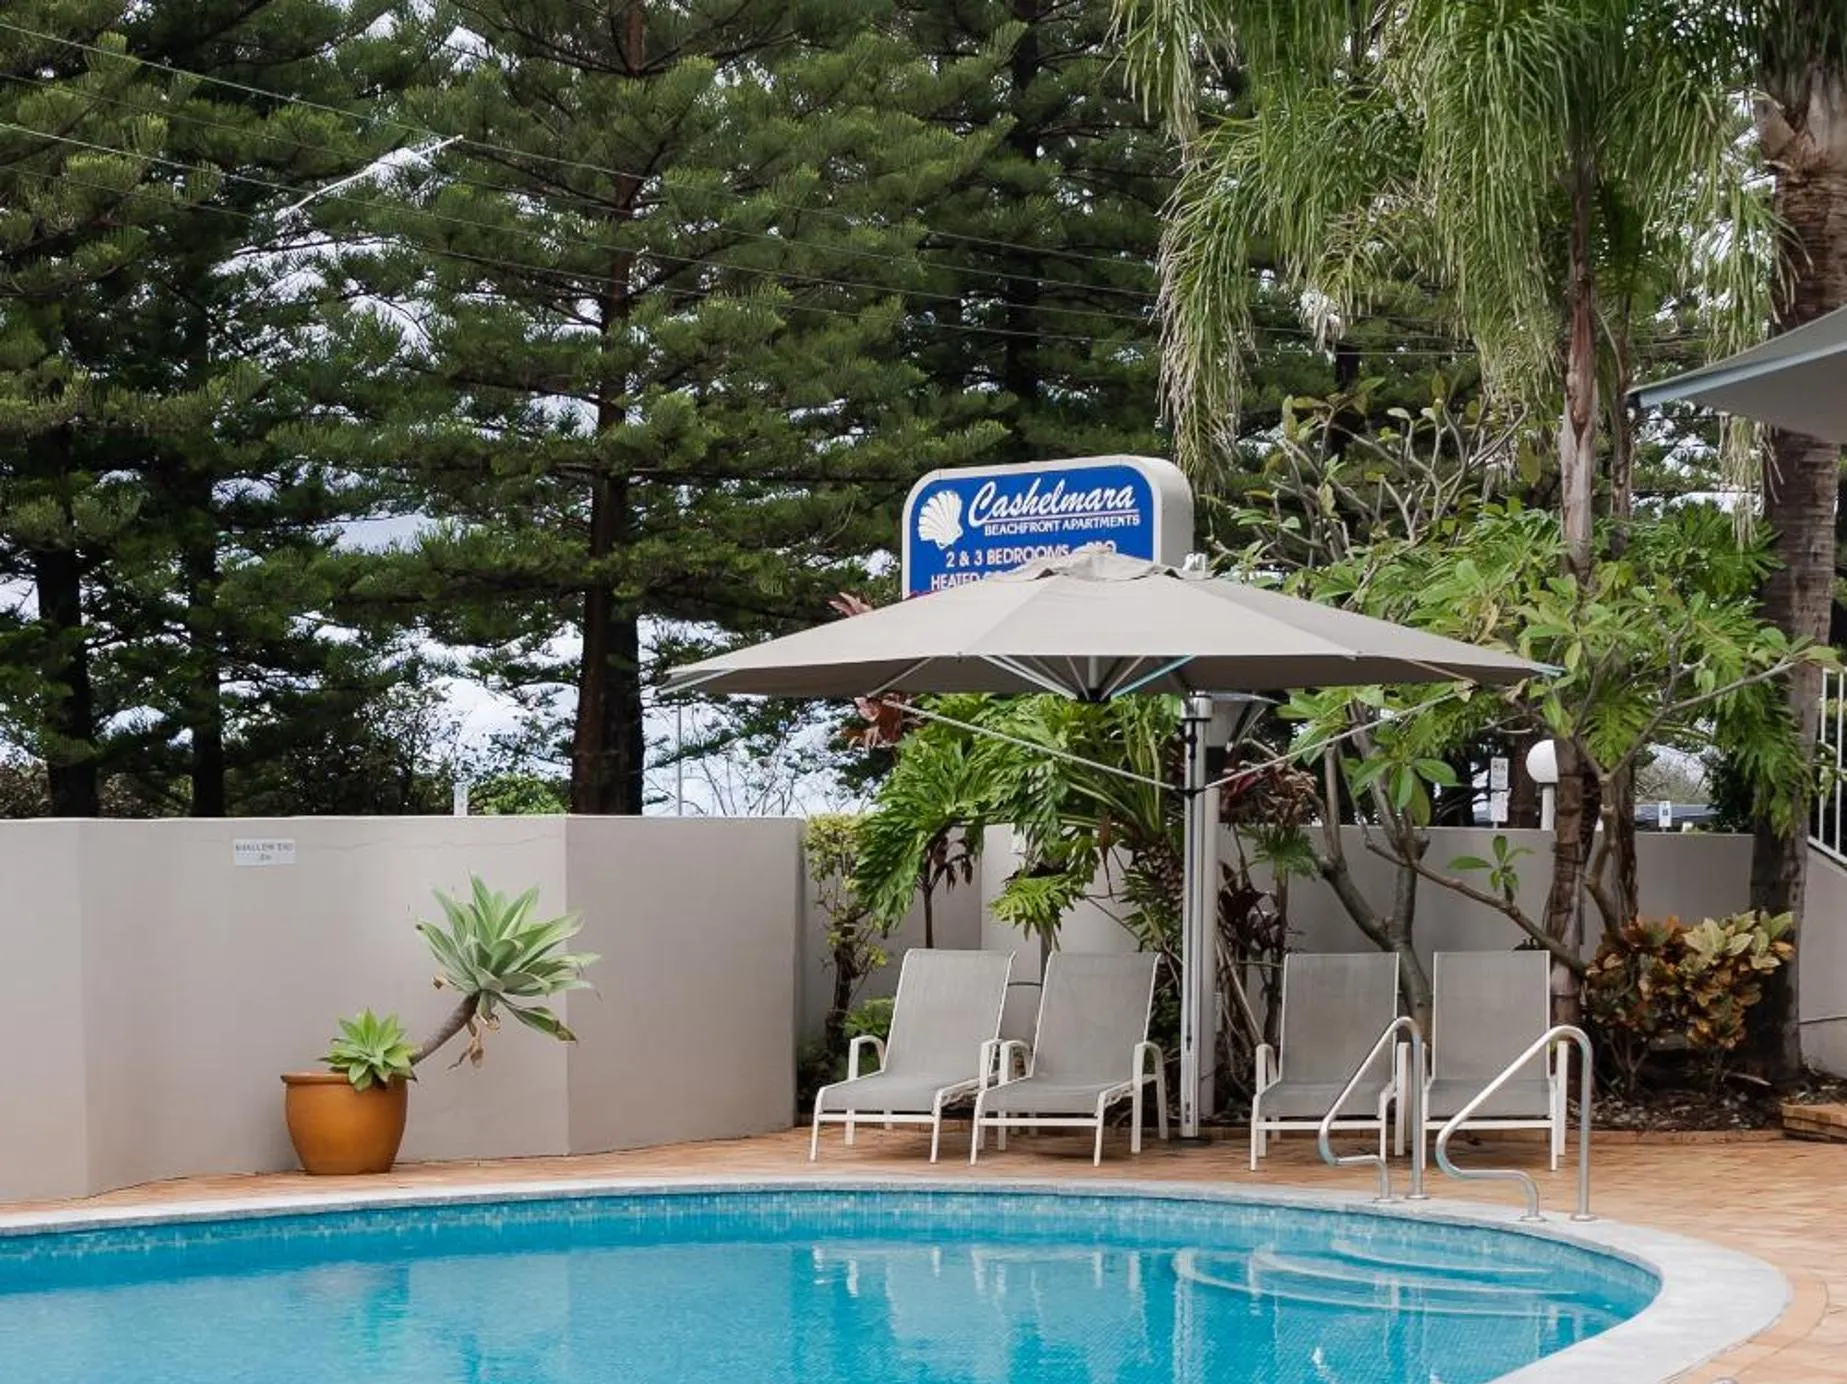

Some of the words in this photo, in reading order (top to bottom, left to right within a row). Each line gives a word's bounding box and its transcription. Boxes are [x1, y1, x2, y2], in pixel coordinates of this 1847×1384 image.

[968, 477, 1136, 528] Cashelmara
[984, 520, 1062, 536] BEACHFRONT
[1062, 514, 1141, 531] APARTMENTS
[946, 551, 955, 568] 2
[960, 550, 970, 566] &
[974, 549, 983, 566] 3
[986, 543, 1070, 565] BEDROOMS
